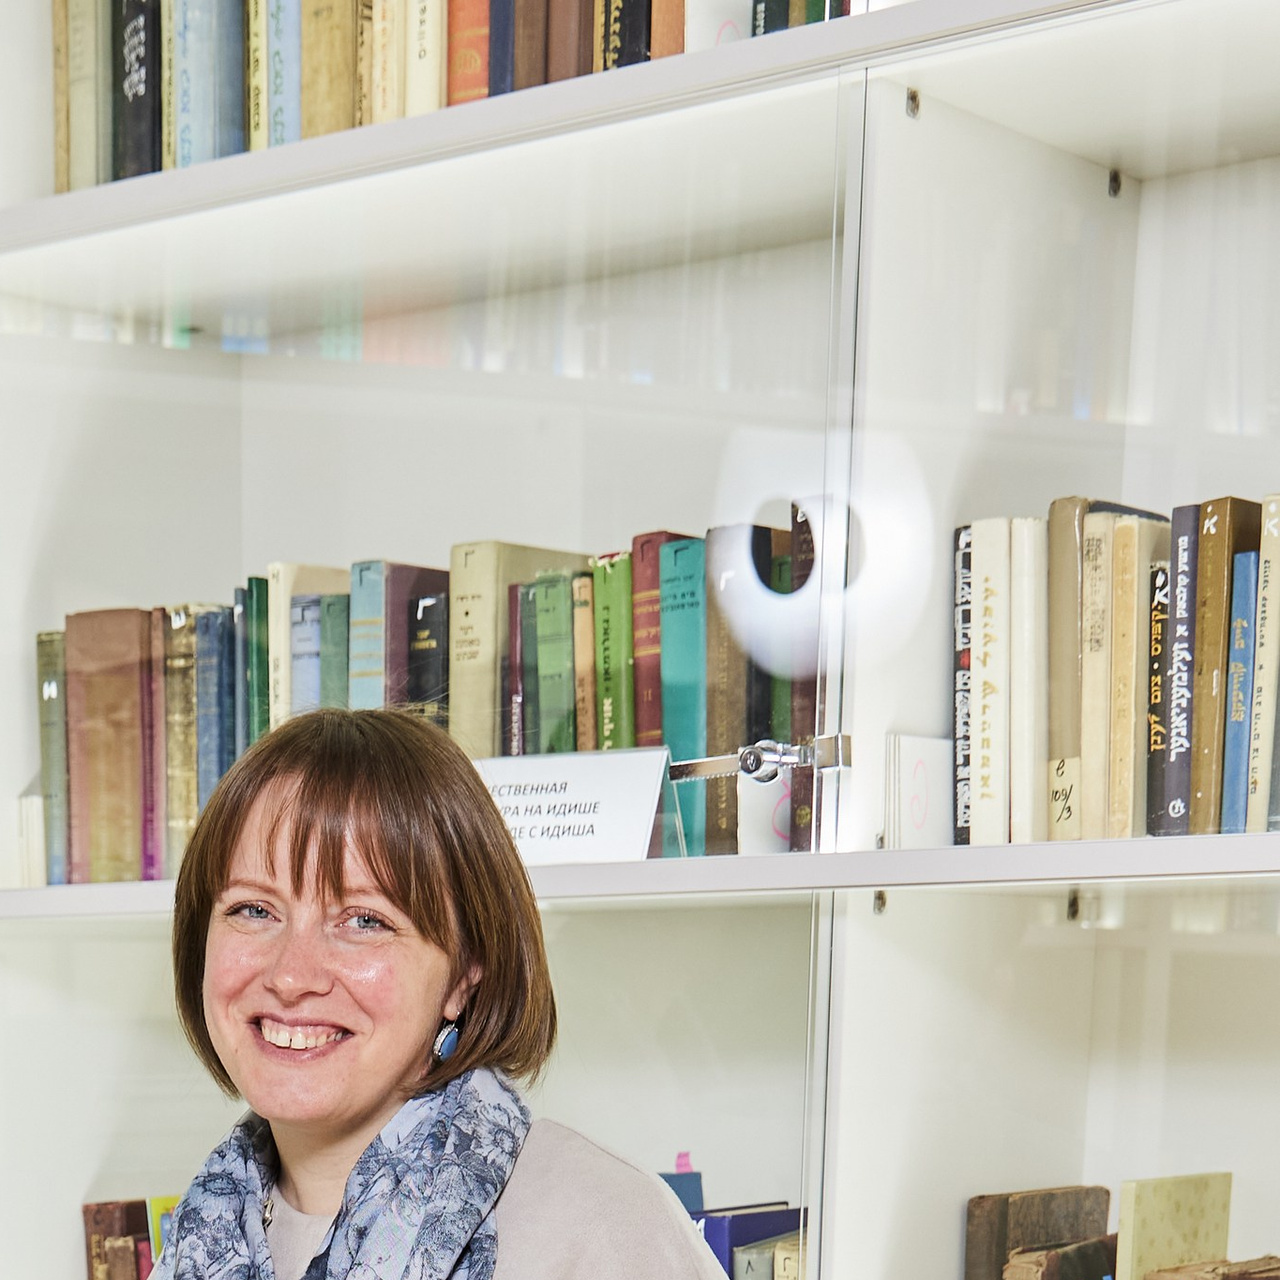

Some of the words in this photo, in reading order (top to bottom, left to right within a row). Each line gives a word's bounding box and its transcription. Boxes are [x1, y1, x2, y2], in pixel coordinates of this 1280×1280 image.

[524, 804, 542, 816] НА
[547, 802, 600, 816] ИДИШЕ
[510, 826, 524, 839] ДЕ
[530, 825, 536, 837] С
[541, 824, 595, 838] ИДИША
